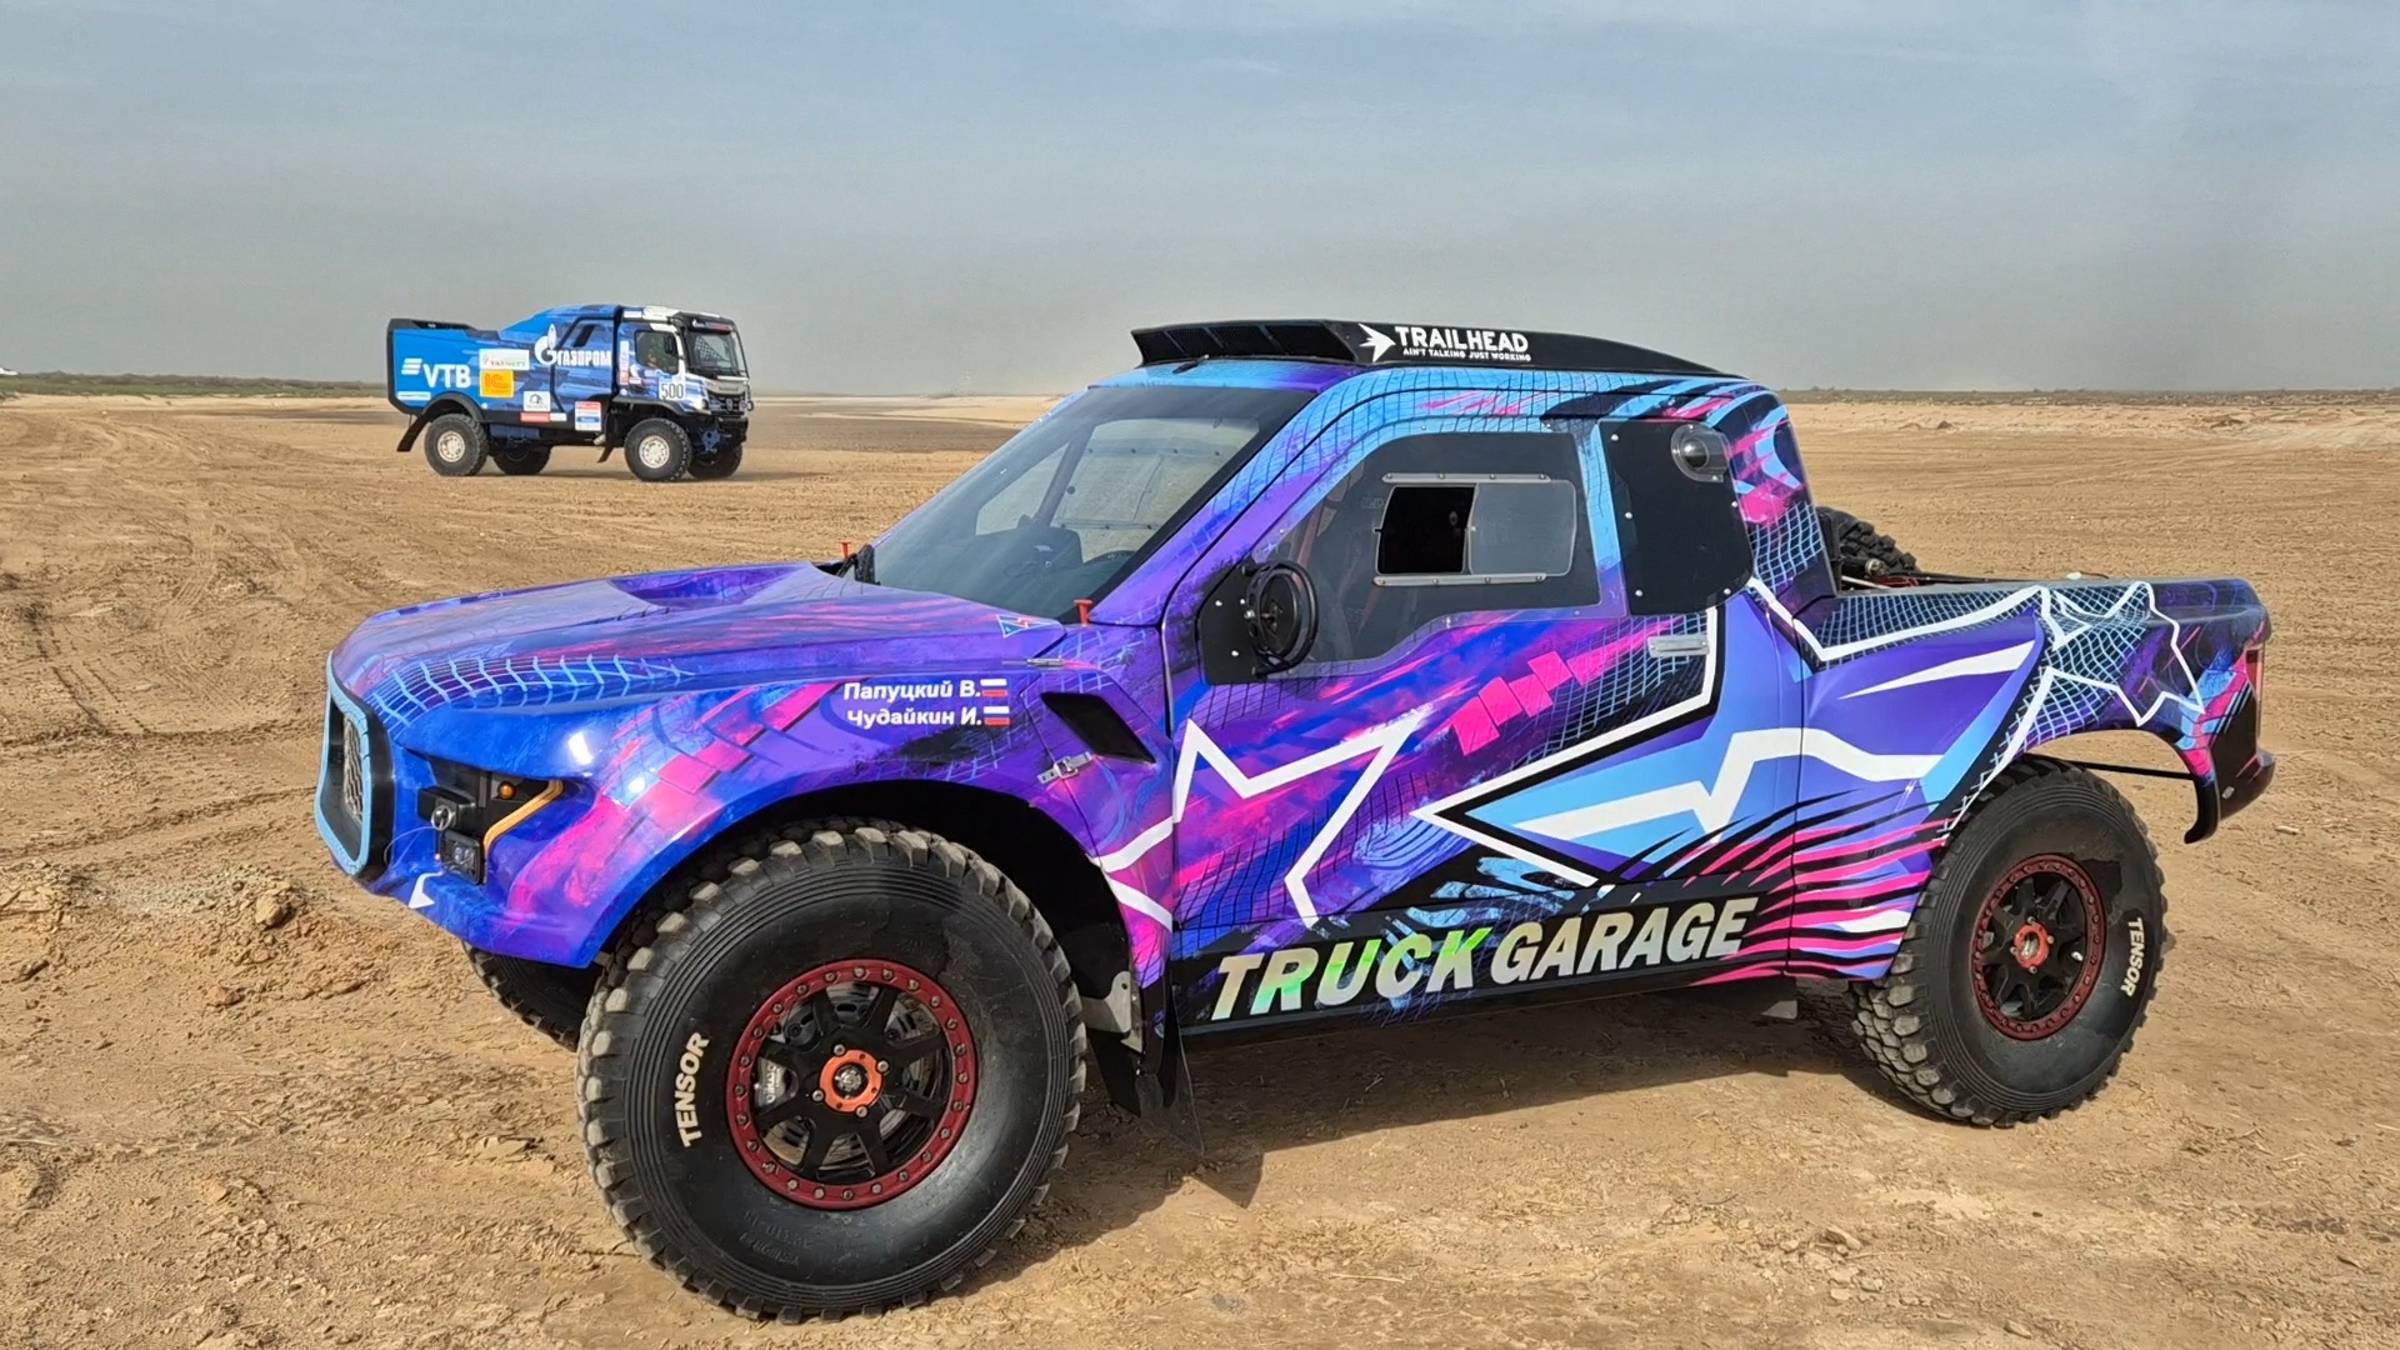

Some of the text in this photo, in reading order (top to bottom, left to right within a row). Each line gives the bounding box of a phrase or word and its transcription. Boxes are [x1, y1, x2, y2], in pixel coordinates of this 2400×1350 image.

[1395, 326, 1529, 353] TRAILHEAD
[556, 350, 612, 367] ГАЗПРОМ
[1428, 349, 1466, 359] TALKING
[1469, 351, 1489, 360] JUST
[1490, 352, 1532, 362] WORKING
[423, 363, 472, 389] VTB
[660, 383, 684, 400] 500
[843, 679, 981, 703] Папуцкий В.
[847, 706, 983, 730] Чудайкин И.
[1211, 896, 1760, 1021] TRUCK GARAGE
[2120, 917, 2145, 997] TENSOR
[674, 1032, 710, 1148] TENSOR
